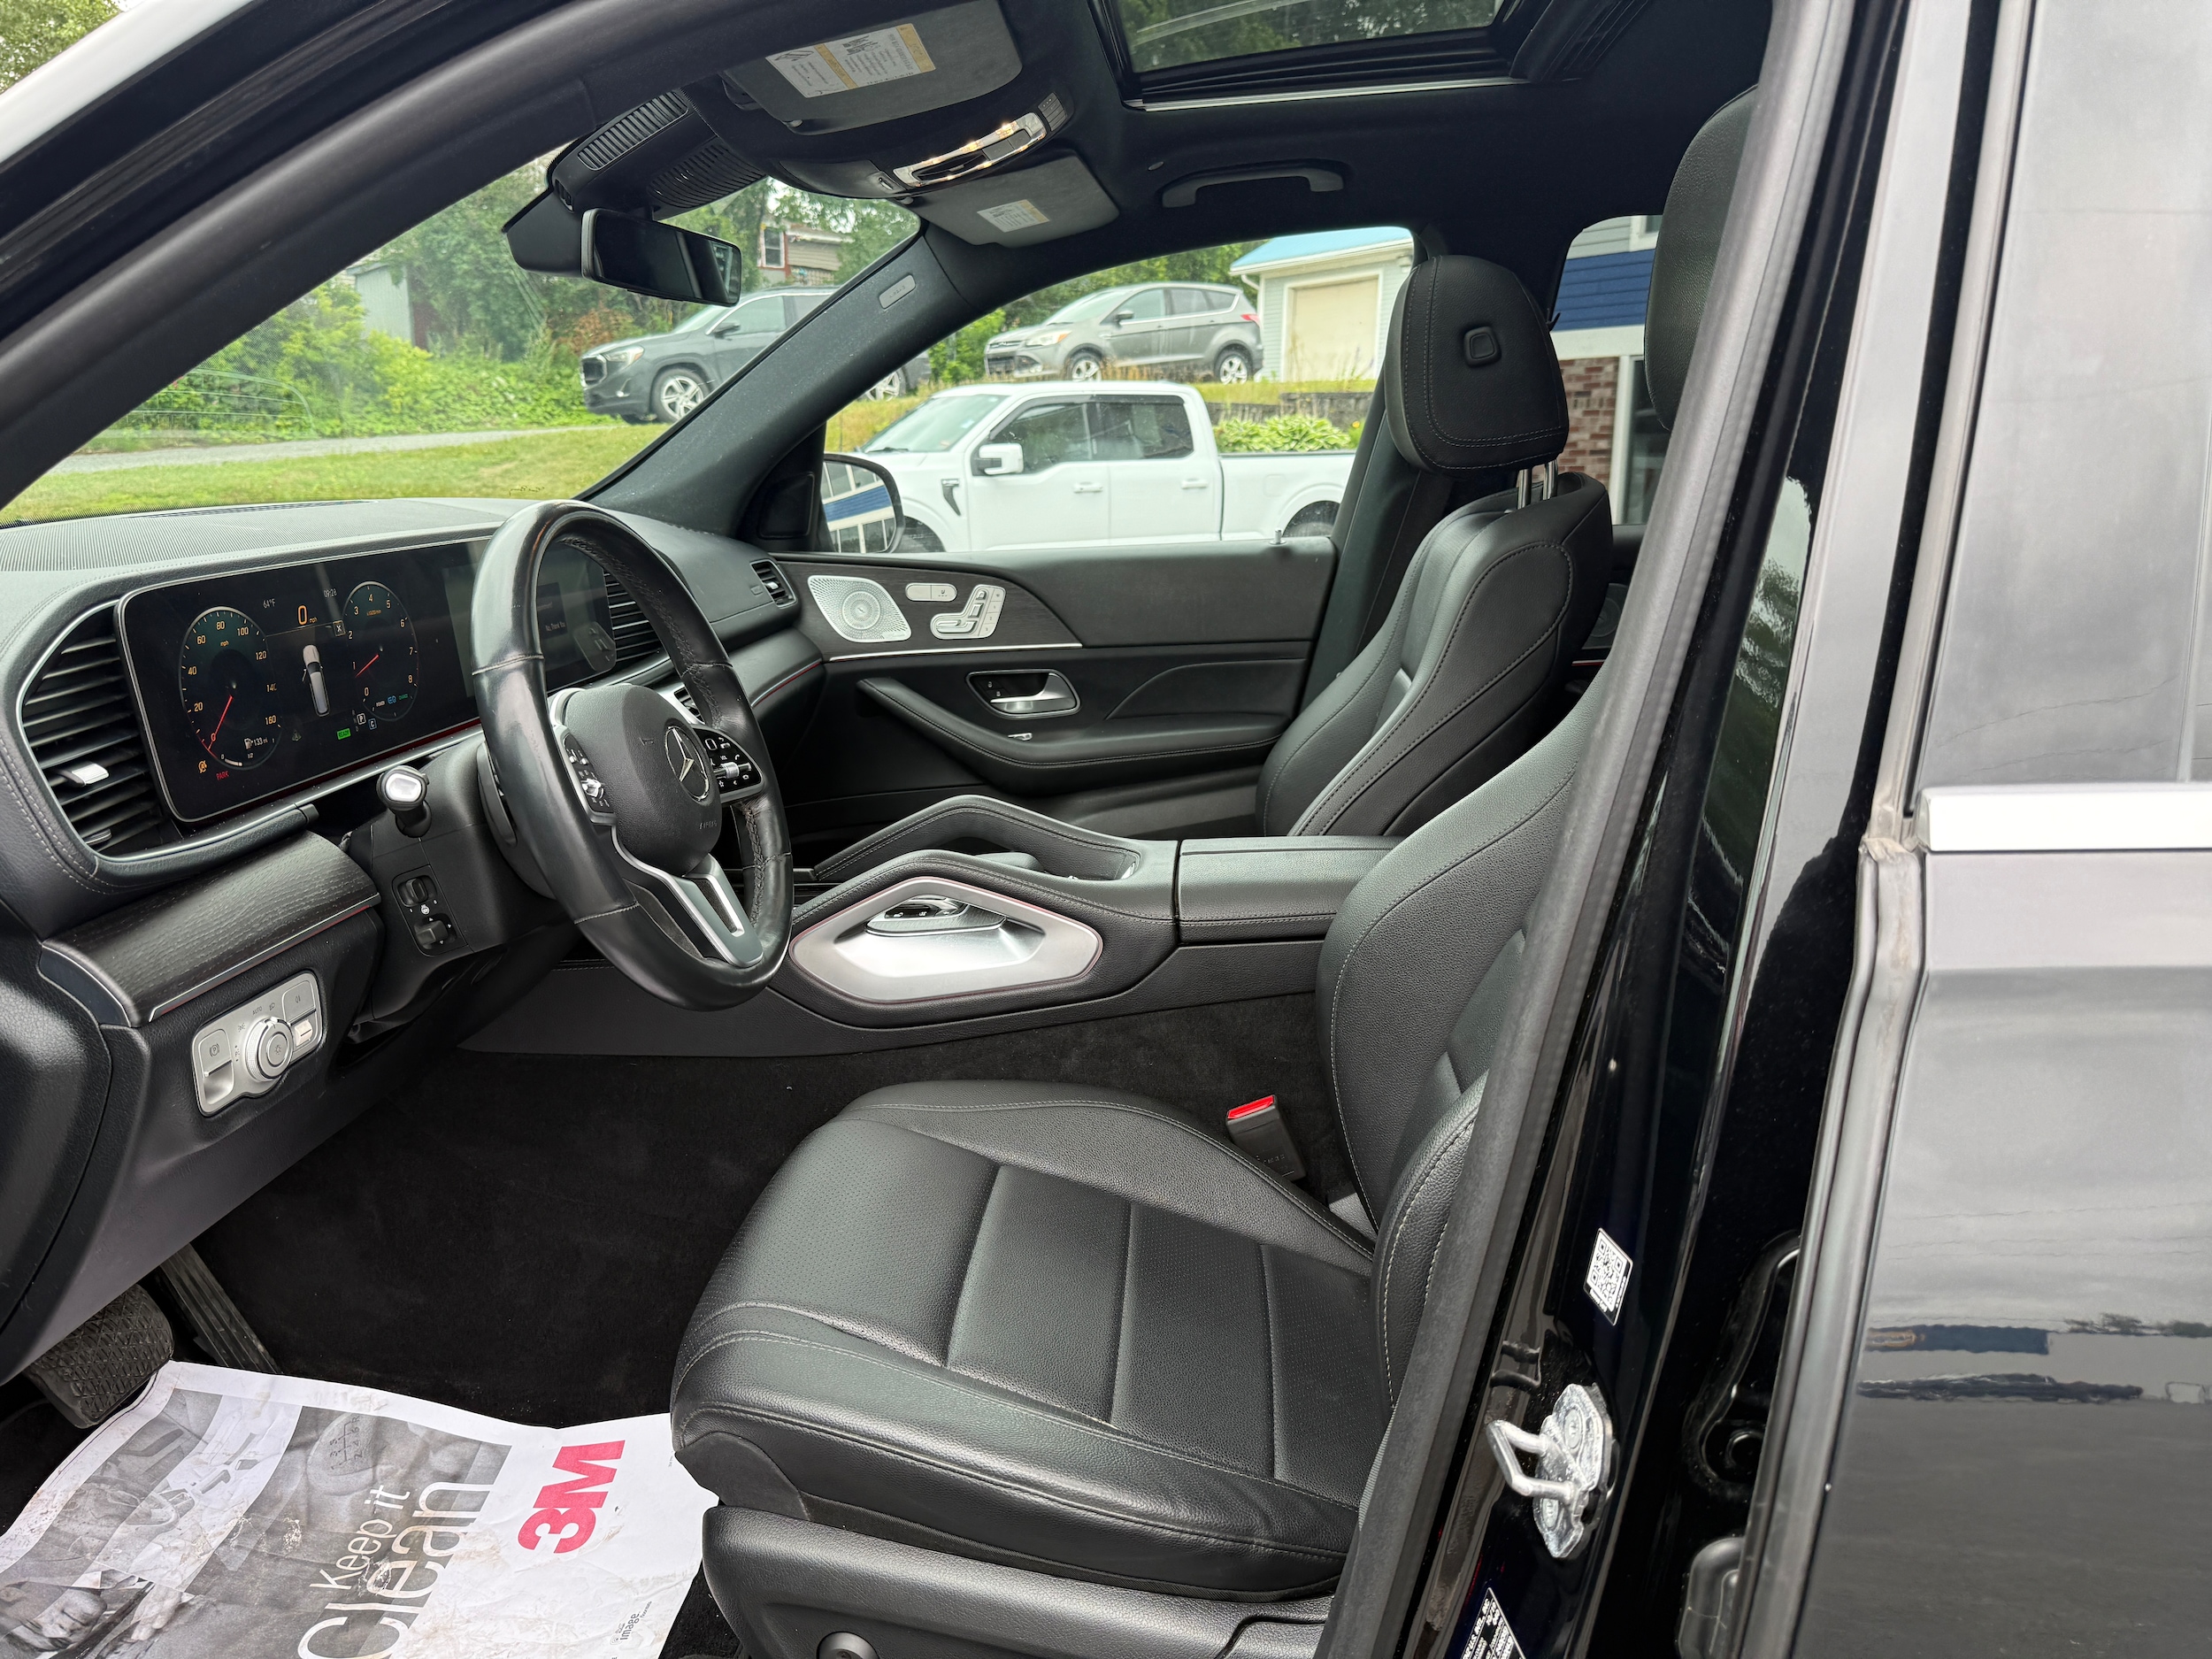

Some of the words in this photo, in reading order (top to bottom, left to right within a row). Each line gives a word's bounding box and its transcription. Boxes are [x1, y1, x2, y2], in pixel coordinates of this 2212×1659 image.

[368, 594, 373, 603] 4
[386, 600, 391, 609] 5
[297, 605, 307, 626] 0
[354, 606, 359, 615] 3
[216, 621, 226, 631] 80
[400, 619, 405, 628] 6
[237, 626, 250, 637] 100
[348, 630, 353, 639] 2
[196, 634, 206, 645] 60
[255, 650, 267, 661] 120
[409, 646, 414, 656] 7
[188, 665, 197, 676] 40
[408, 674, 413, 683] 8
[364, 687, 370, 696] 0
[194, 702, 204, 712] 20
[265, 715, 277, 726] 160
[253, 737, 264, 747] 133
[216, 770, 229, 780] PARK
[252, 1005, 263, 1016] AUTO
[517, 1440, 626, 1554] 3M
[310, 1518, 397, 1590] Keep
[364, 1485, 411, 1509] it
[297, 1481, 494, 1659] Clean
